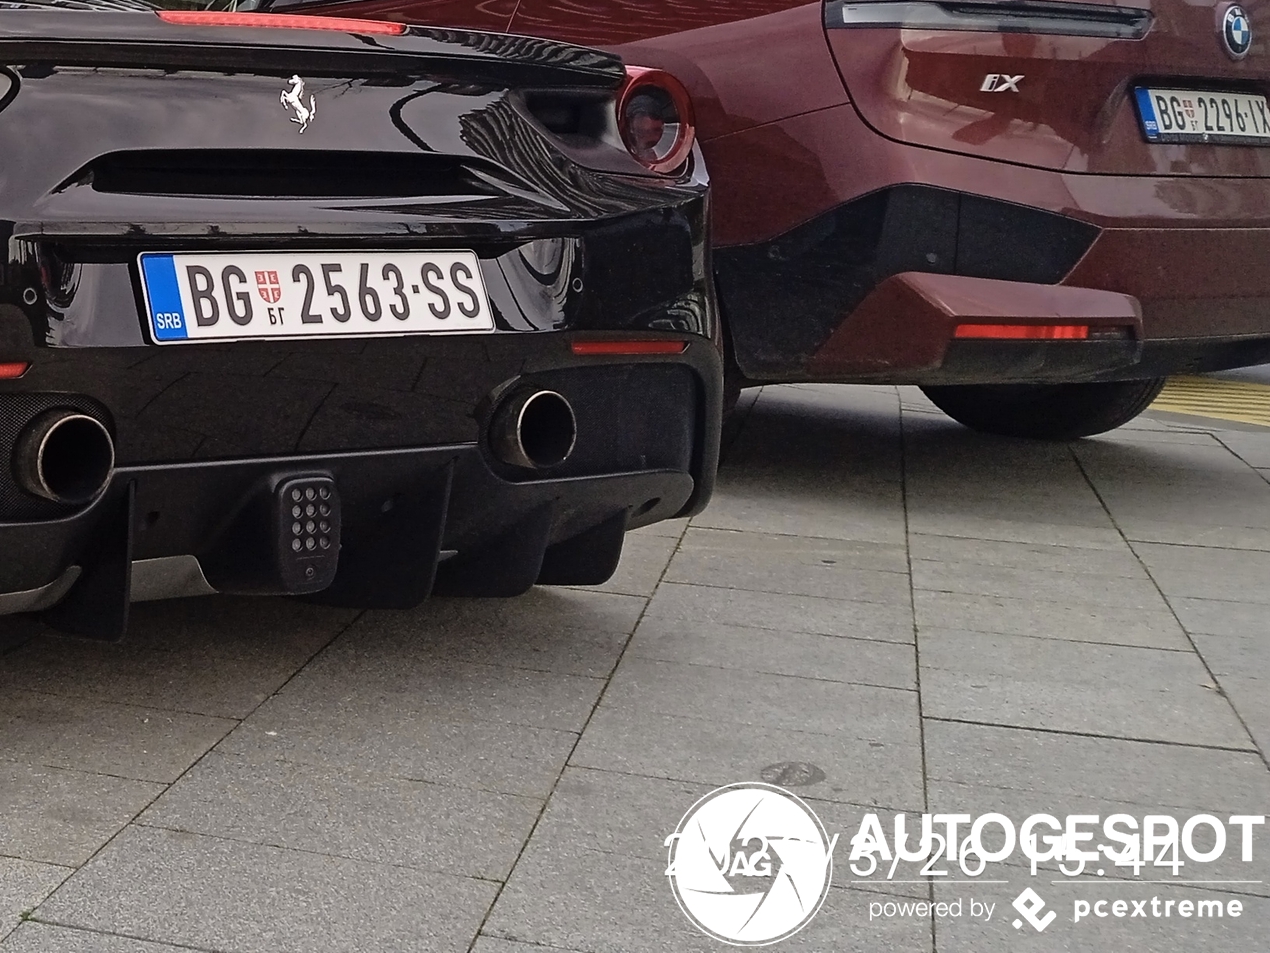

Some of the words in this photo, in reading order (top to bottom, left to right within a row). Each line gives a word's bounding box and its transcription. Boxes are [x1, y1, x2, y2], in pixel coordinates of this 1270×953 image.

[980, 74, 1025, 93] iX
[1155, 95, 1186, 131] BG
[186, 264, 254, 327] BG
[156, 312, 182, 329] SRB
